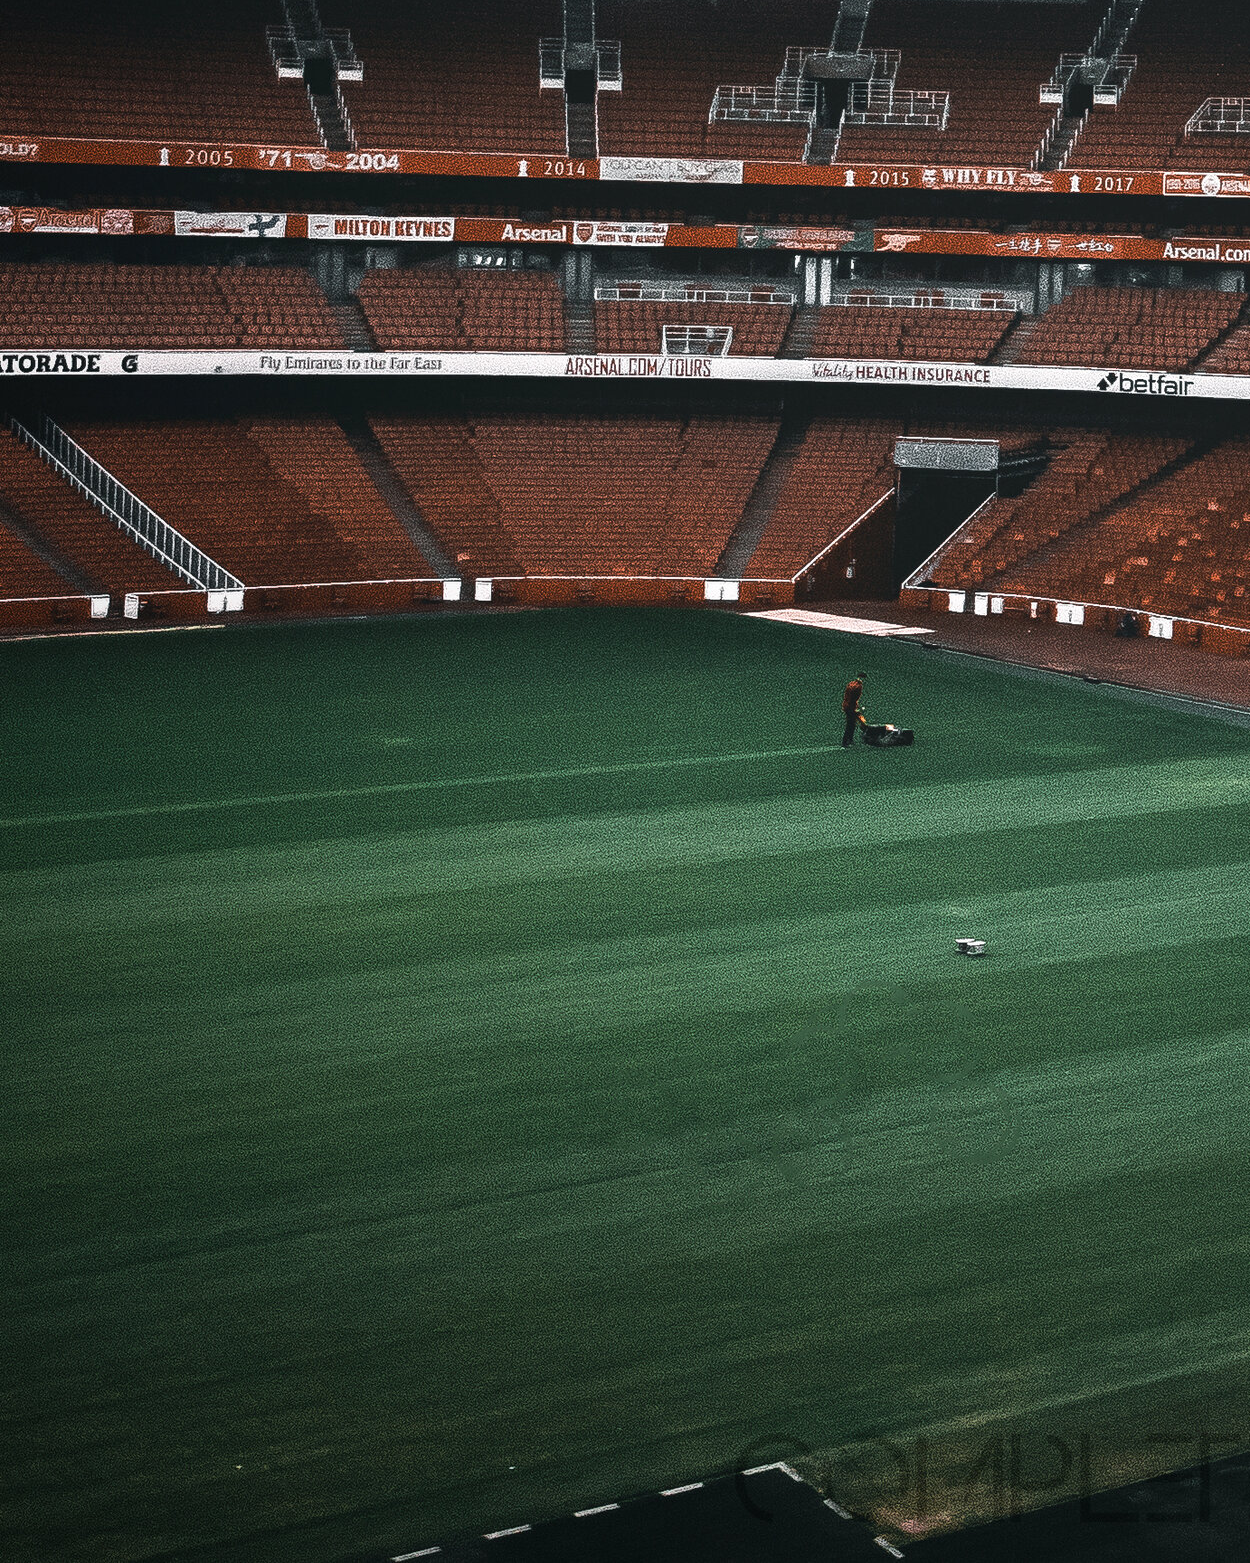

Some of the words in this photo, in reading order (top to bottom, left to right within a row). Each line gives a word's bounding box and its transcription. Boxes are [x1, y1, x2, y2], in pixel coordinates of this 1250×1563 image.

[185, 149, 234, 165] 2005
[346, 153, 400, 170] 2004
[543, 161, 586, 176] 2014
[941, 168, 985, 185] WHY
[986, 169, 1018, 186] FLY
[869, 170, 909, 186] 2015
[1094, 177, 1134, 192] 2017
[334, 219, 390, 235] MILTON
[395, 221, 451, 237] KEYNES
[501, 224, 567, 242] Arsenal
[0, 354, 100, 373] TORADE
[121, 354, 139, 373] G
[259, 356, 281, 371] Fly
[285, 356, 342, 370] Emirates
[347, 357, 360, 370] to
[365, 357, 386, 370] the
[389, 357, 411, 370] Far
[415, 357, 442, 370] East
[564, 357, 712, 377] ARSENAL.COM/TOURS
[812, 362, 854, 381] Vitality
[856, 366, 908, 381] HEALTH
[912, 367, 991, 383] INSURANCE
[1119, 373, 1194, 395] betfair
